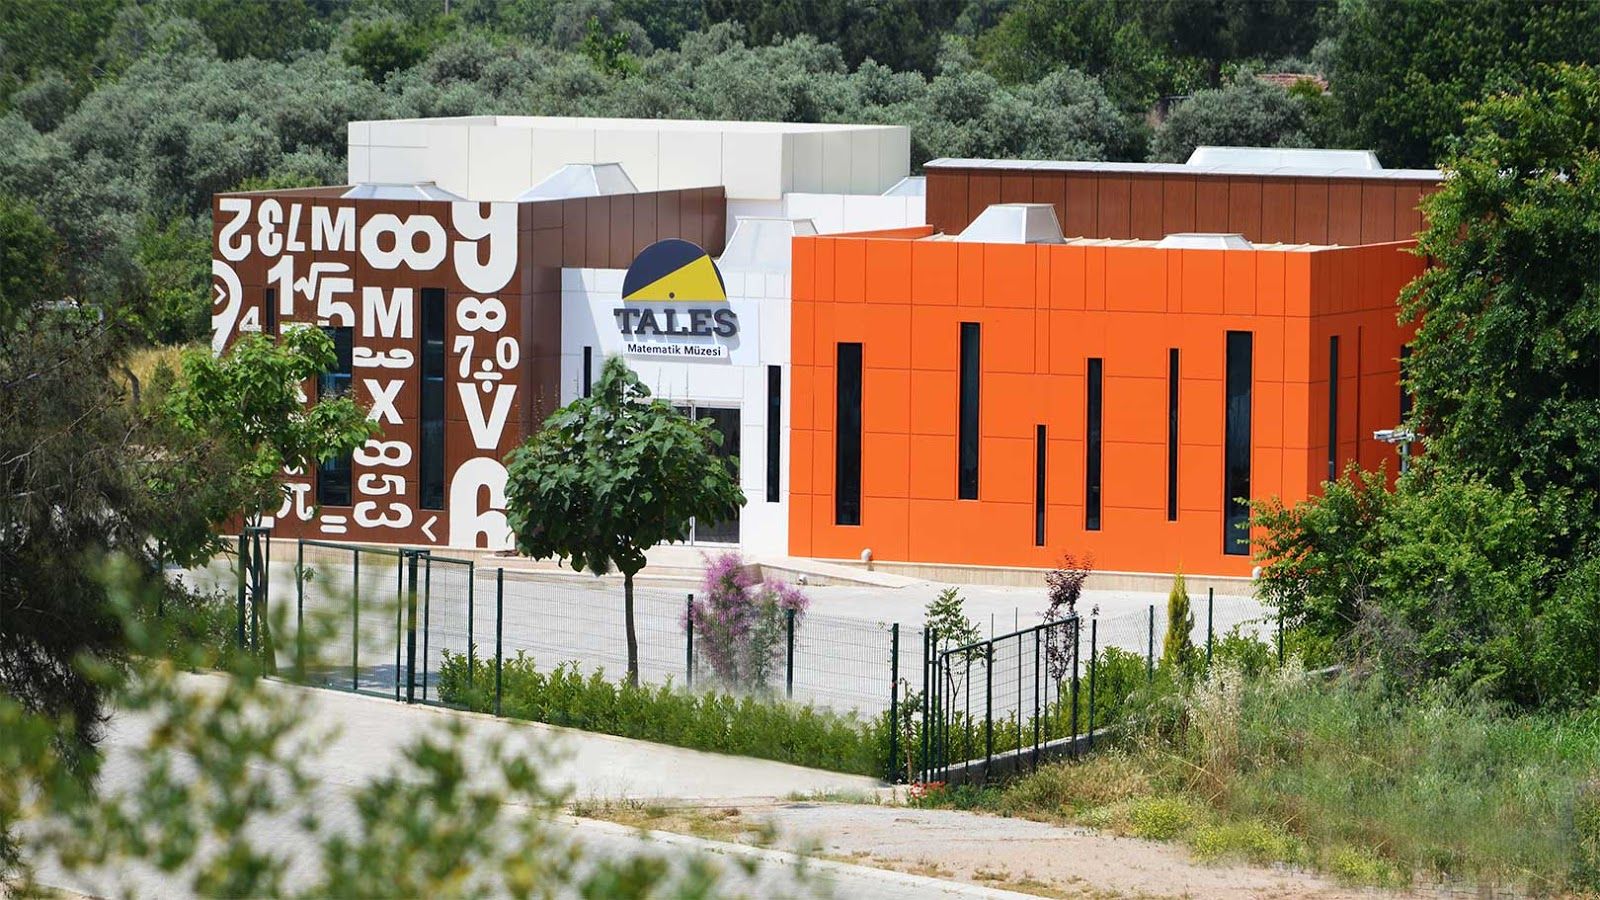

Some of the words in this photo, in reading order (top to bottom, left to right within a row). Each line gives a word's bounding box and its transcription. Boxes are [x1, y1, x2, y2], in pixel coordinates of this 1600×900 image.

[362, 287, 414, 339] M
[613, 308, 738, 337] TALES
[627, 343, 681, 355] Matematik
[684, 345, 721, 356] Müzesi
[363, 378, 405, 425] X
[456, 382, 518, 450] V
